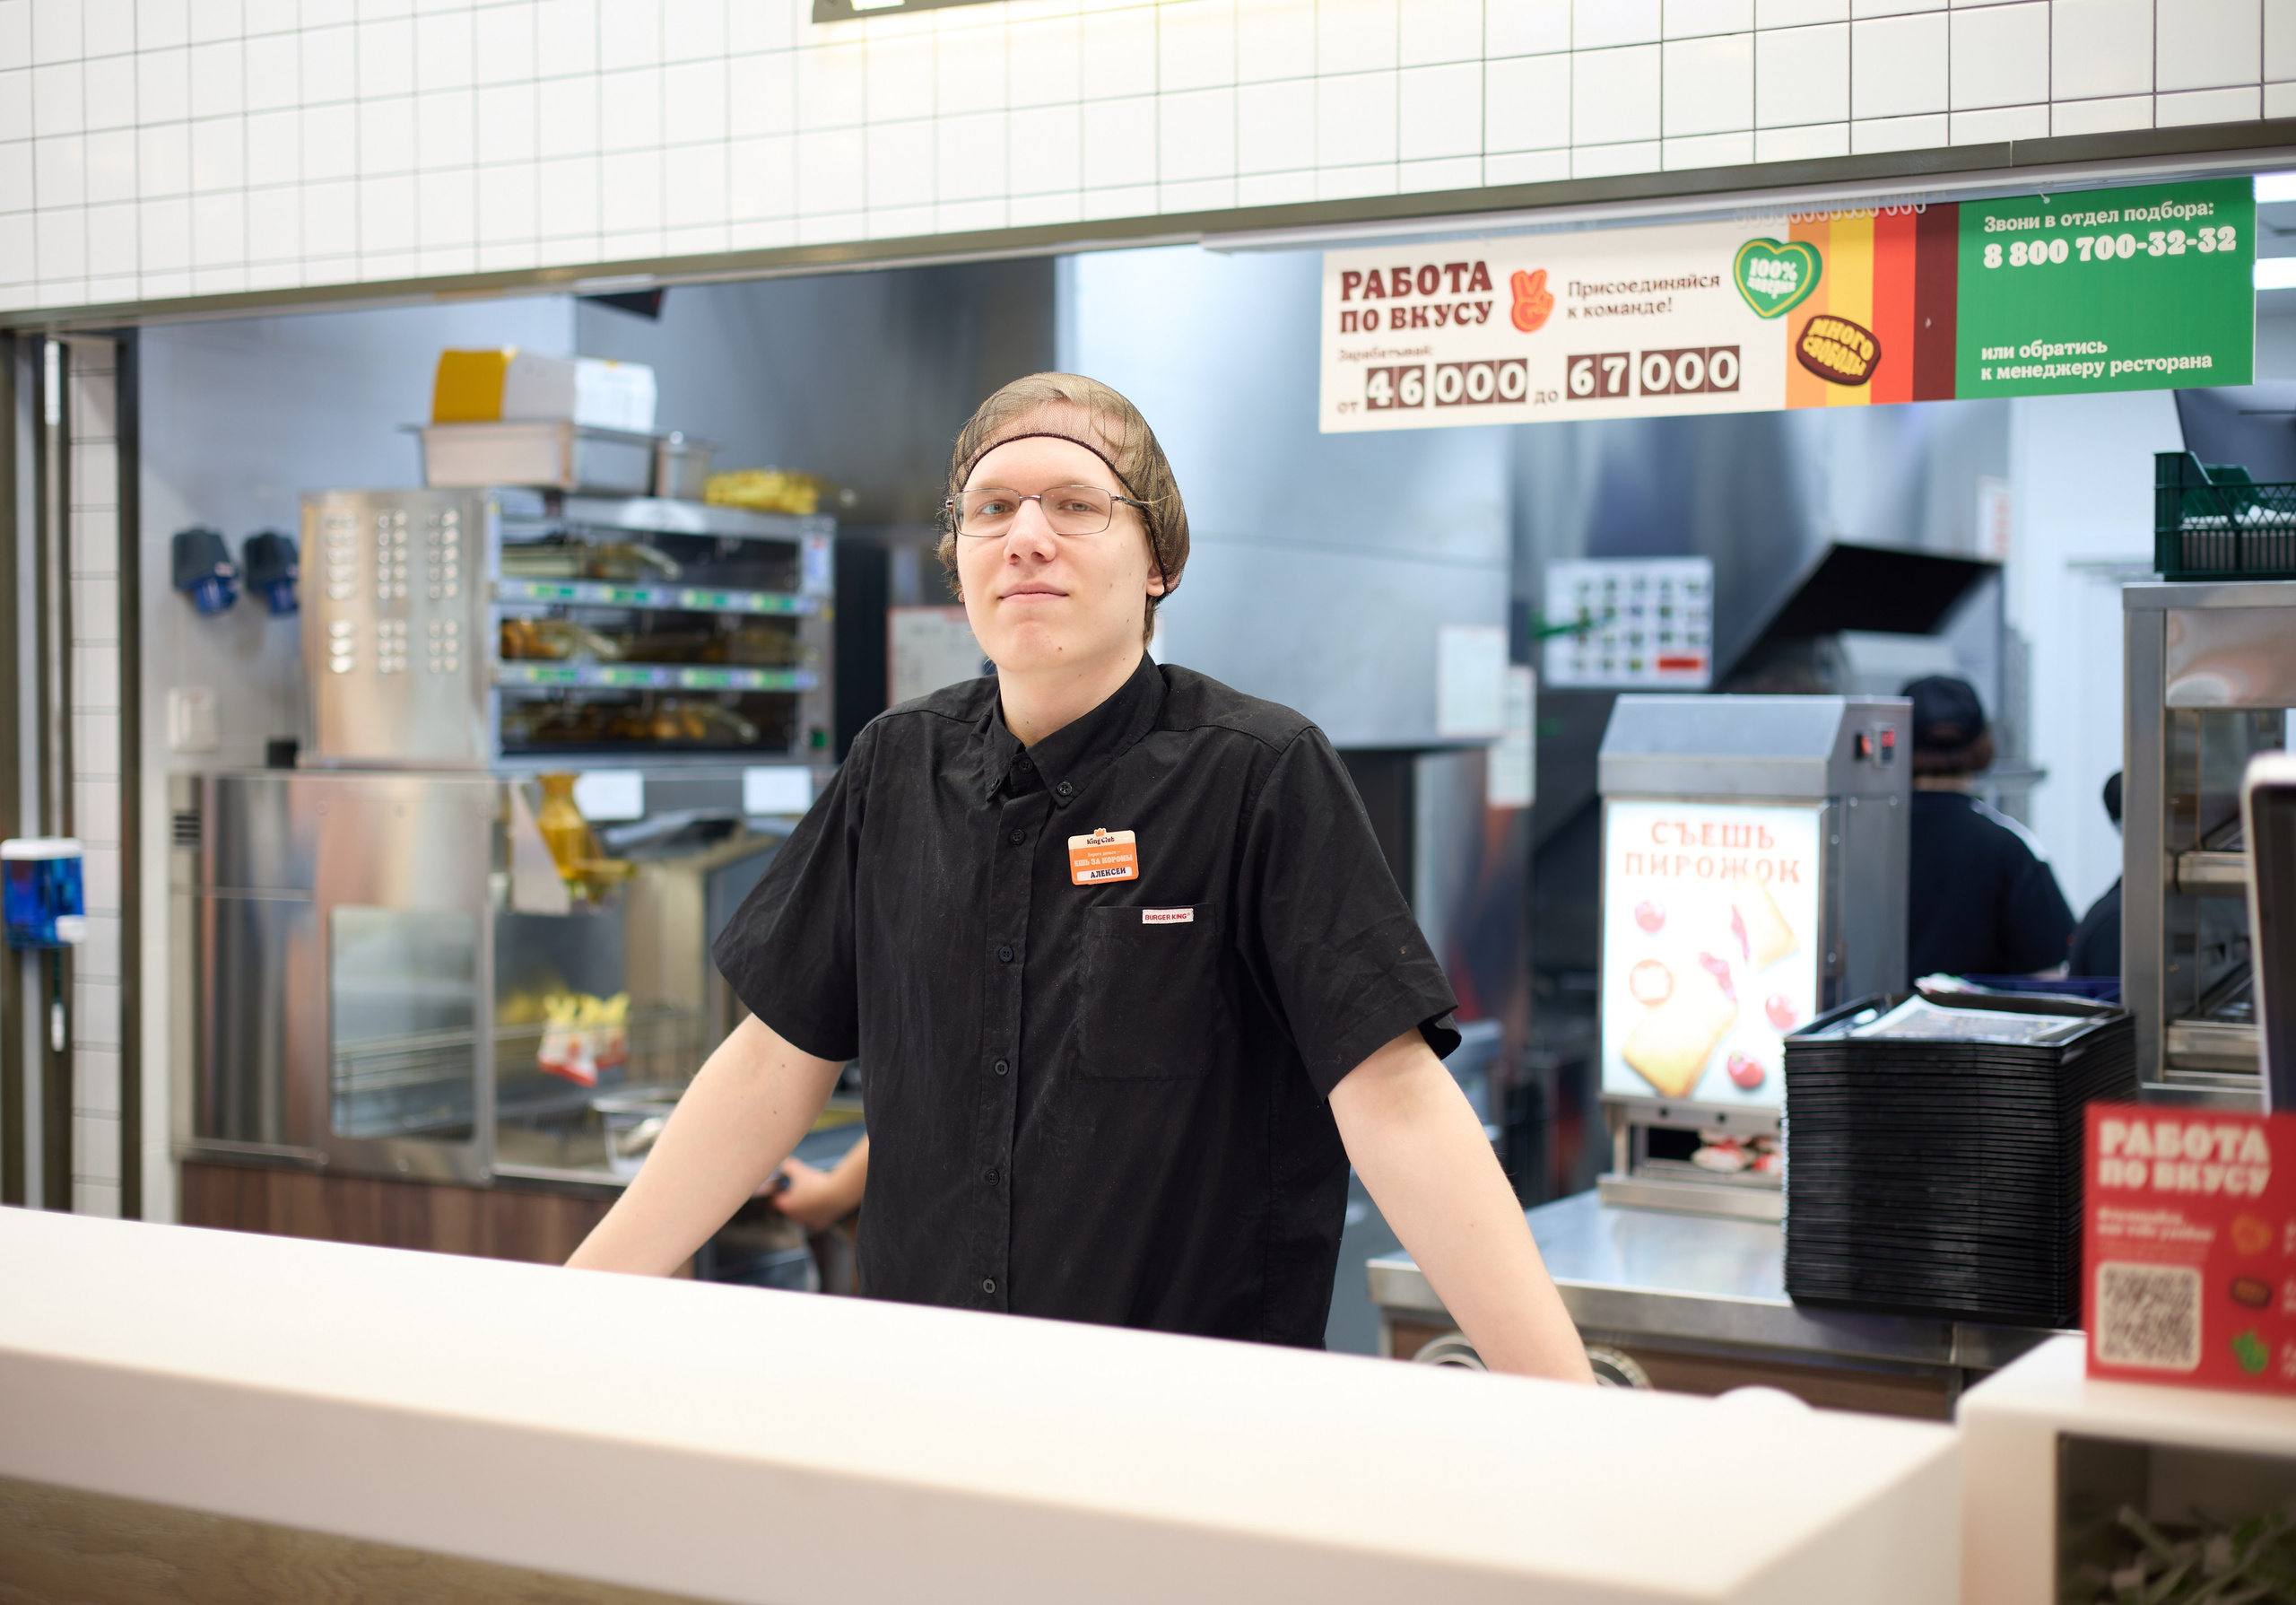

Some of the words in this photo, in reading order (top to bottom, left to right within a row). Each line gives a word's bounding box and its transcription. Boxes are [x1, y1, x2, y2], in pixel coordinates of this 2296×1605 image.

[1984, 216, 2039, 232] Звони
[2045, 216, 2056, 228] в
[2061, 210, 2119, 227] отдел
[2124, 201, 2214, 221] подбора:
[1983, 243, 2003, 269] 8
[2009, 239, 2069, 267] 800
[2075, 225, 2237, 262] 700-32-32
[1342, 260, 1493, 301] РАБОТА
[1749, 257, 1798, 282] 100%
[1569, 275, 1721, 301] Присоединяйся
[1341, 309, 1379, 333] ПО
[1390, 301, 1493, 330] ВКУСУ
[1568, 307, 1578, 319] к
[1583, 297, 1673, 318] команде!
[1808, 318, 1874, 361] МНОГО
[1981, 346, 2014, 360] или
[2019, 340, 2108, 361] обратись
[1981, 367, 1992, 380] к
[1996, 362, 2105, 379] менеджеру
[2109, 355, 2213, 377] ресторана
[1337, 402, 1358, 414] от
[1368, 368, 1424, 407] 46
[1534, 389, 1559, 405] до
[1570, 356, 1628, 397] 67
[1651, 820, 1774, 850] СЪЕШЬ
[1102, 855, 1133, 864] КОРОНЫ
[1625, 852, 1800, 884] ПИРОЖОК
[2100, 1121, 2270, 1164] РАБОТА
[2099, 1158, 2148, 1189] ПО
[2153, 1162, 2271, 1198] ВКУСУ
